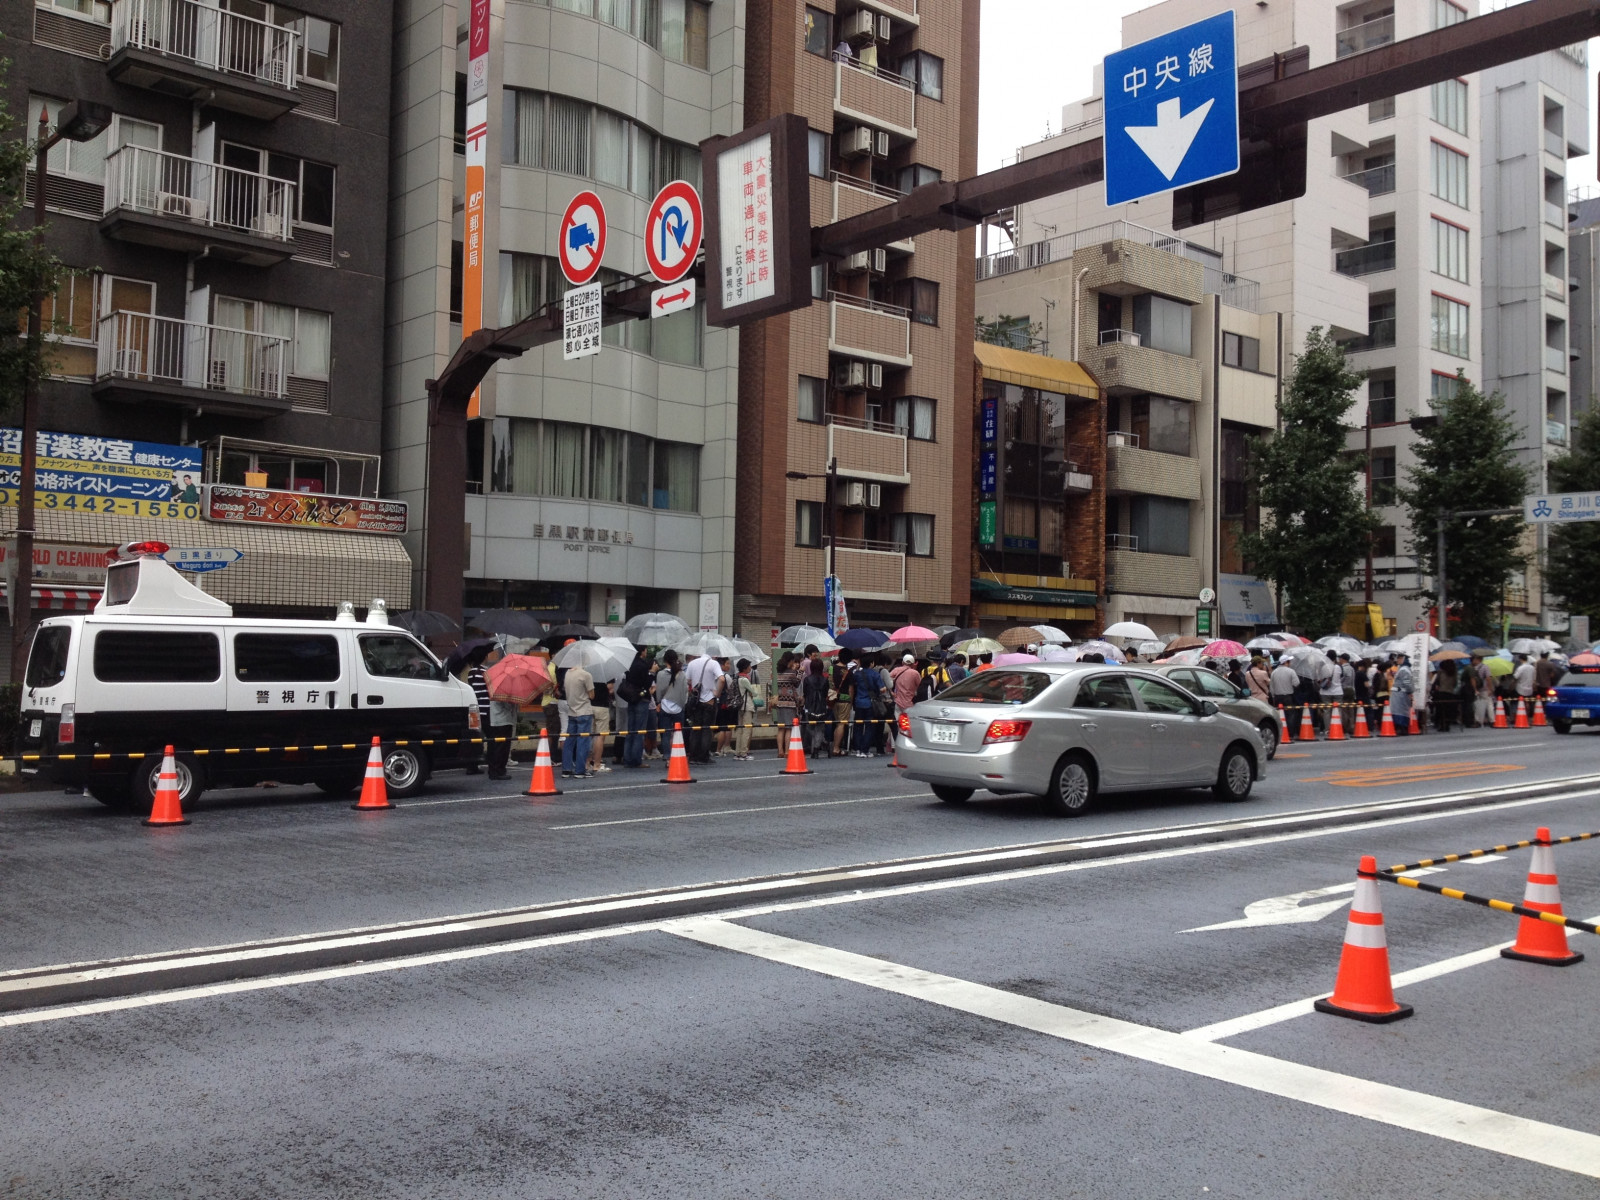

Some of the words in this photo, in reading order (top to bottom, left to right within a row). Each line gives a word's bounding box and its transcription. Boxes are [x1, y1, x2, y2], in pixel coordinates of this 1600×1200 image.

[1123, 43, 1214, 98] 中央線
[743, 160, 756, 286] 車両通行禁止
[756, 156, 769, 281] 大震災等発生時
[469, 214, 479, 268] 郵便局
[735, 245, 743, 299] になります
[566, 289, 600, 310] 土曜日22時から
[566, 303, 600, 323] 日曜日7時まで
[565, 335, 600, 354] 都心全域
[134, 452, 201, 468] 健康センター
[533, 523, 634, 545] 目黒駅前郵便局
[180, 551, 222, 560] 目黒通り
[563, 543, 584, 552] POST
[587, 545, 611, 554] OFFICE
[56, 550, 109, 568] CLEANING
[256, 690, 320, 704] 警視庁
